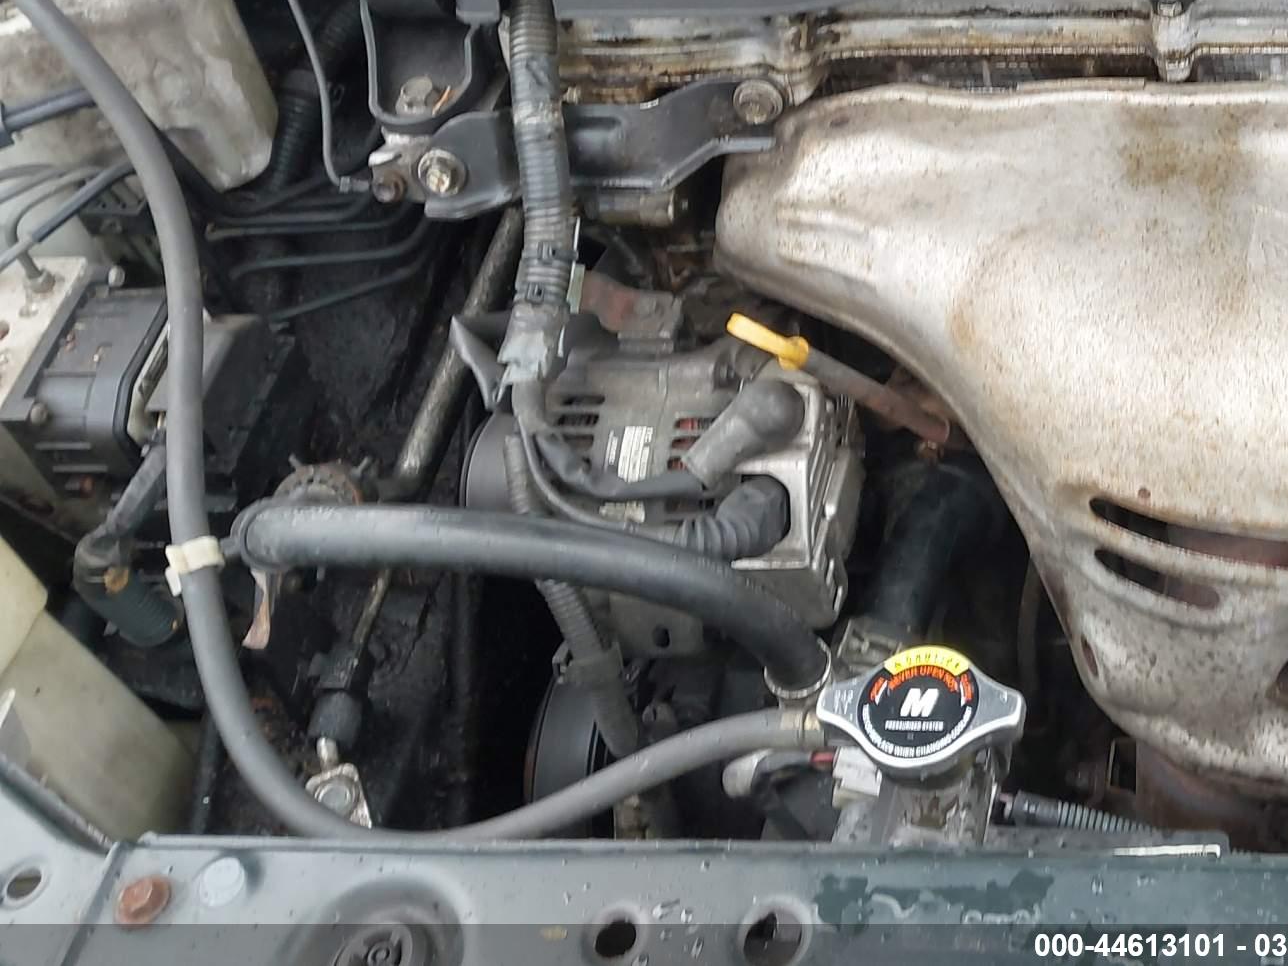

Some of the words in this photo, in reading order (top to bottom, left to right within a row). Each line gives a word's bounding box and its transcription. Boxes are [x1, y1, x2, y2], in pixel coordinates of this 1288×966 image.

[919, 665, 944, 680] OPEN
[899, 687, 940, 718] M
[922, 720, 944, 732] SYSTEM
